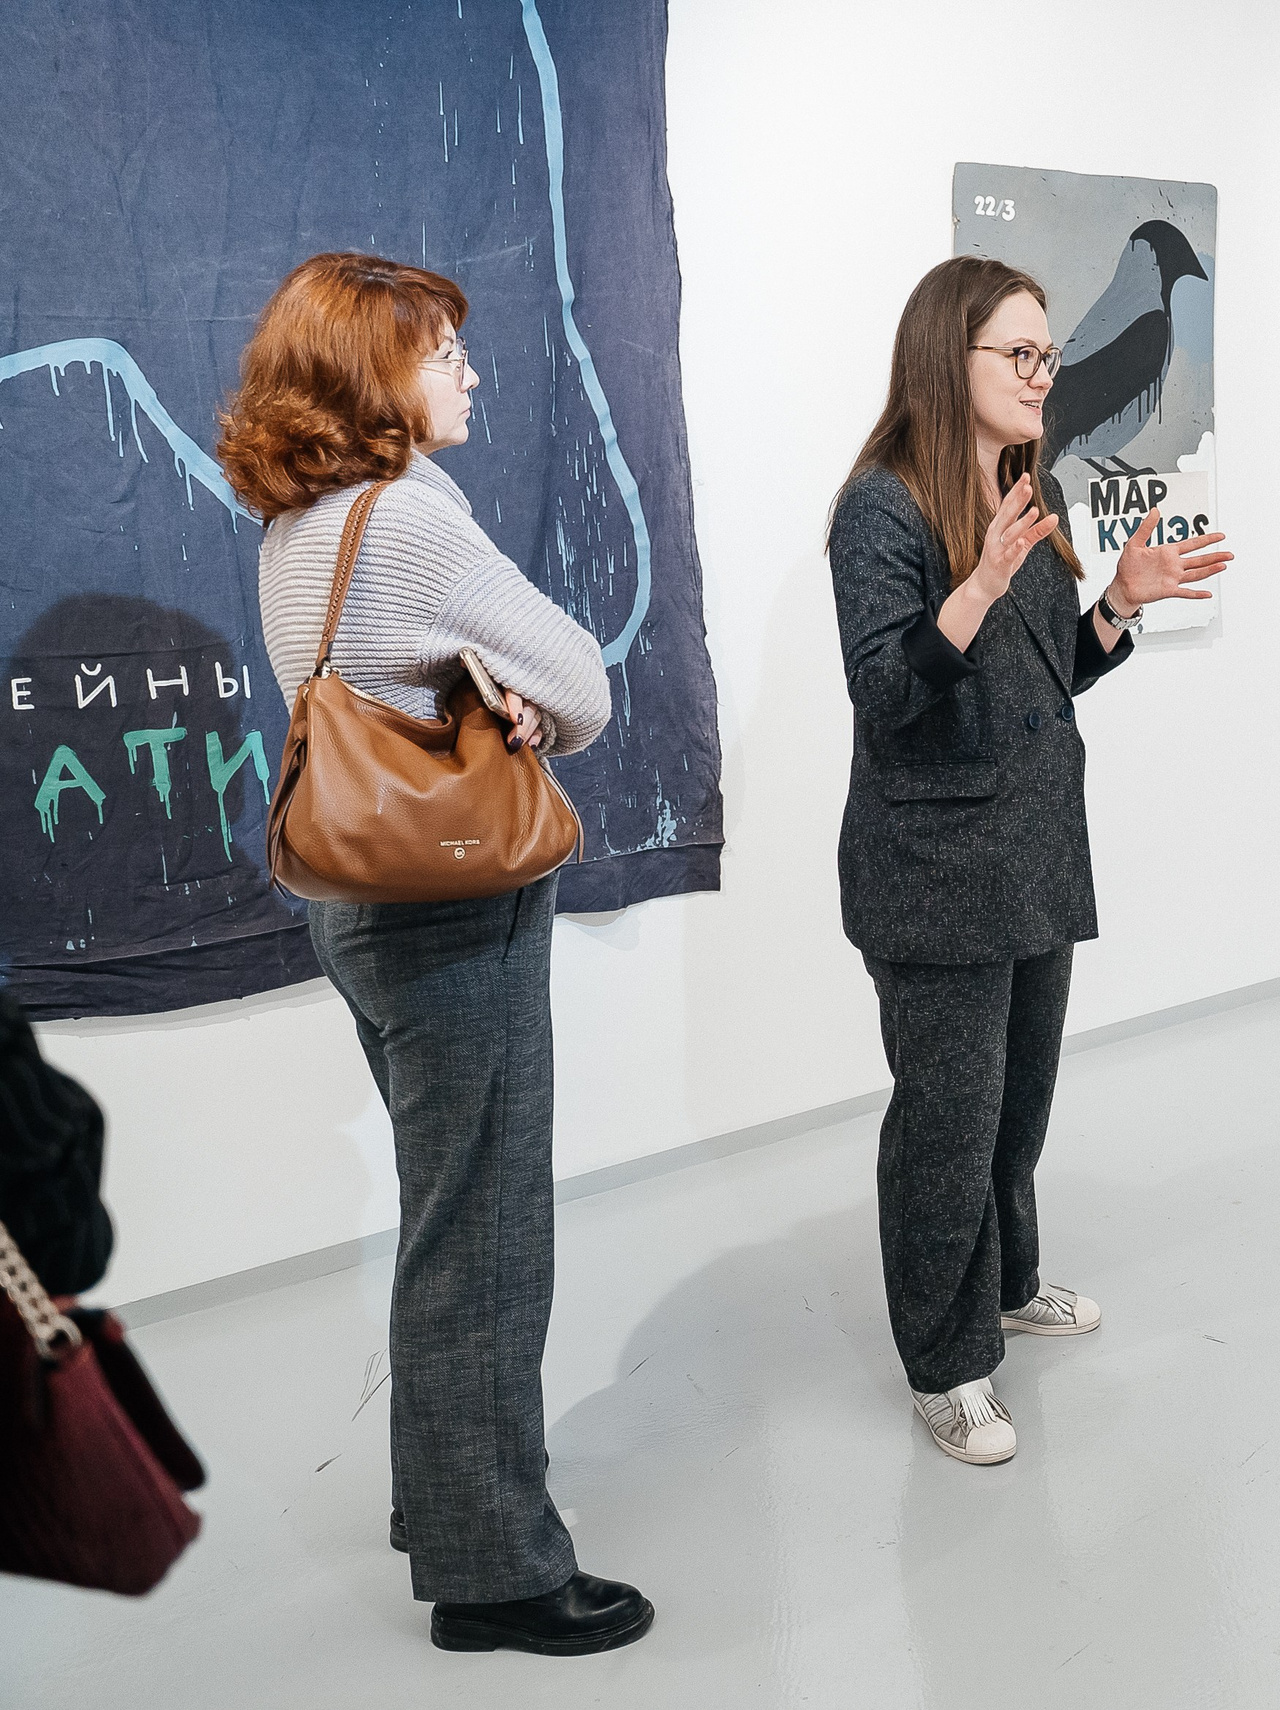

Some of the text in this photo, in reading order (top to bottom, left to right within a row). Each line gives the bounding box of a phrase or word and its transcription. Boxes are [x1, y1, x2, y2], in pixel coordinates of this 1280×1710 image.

[974, 195, 1016, 222] 22/3
[1090, 479, 1168, 518] МАР
[440, 839, 464, 847] MICHAEL
